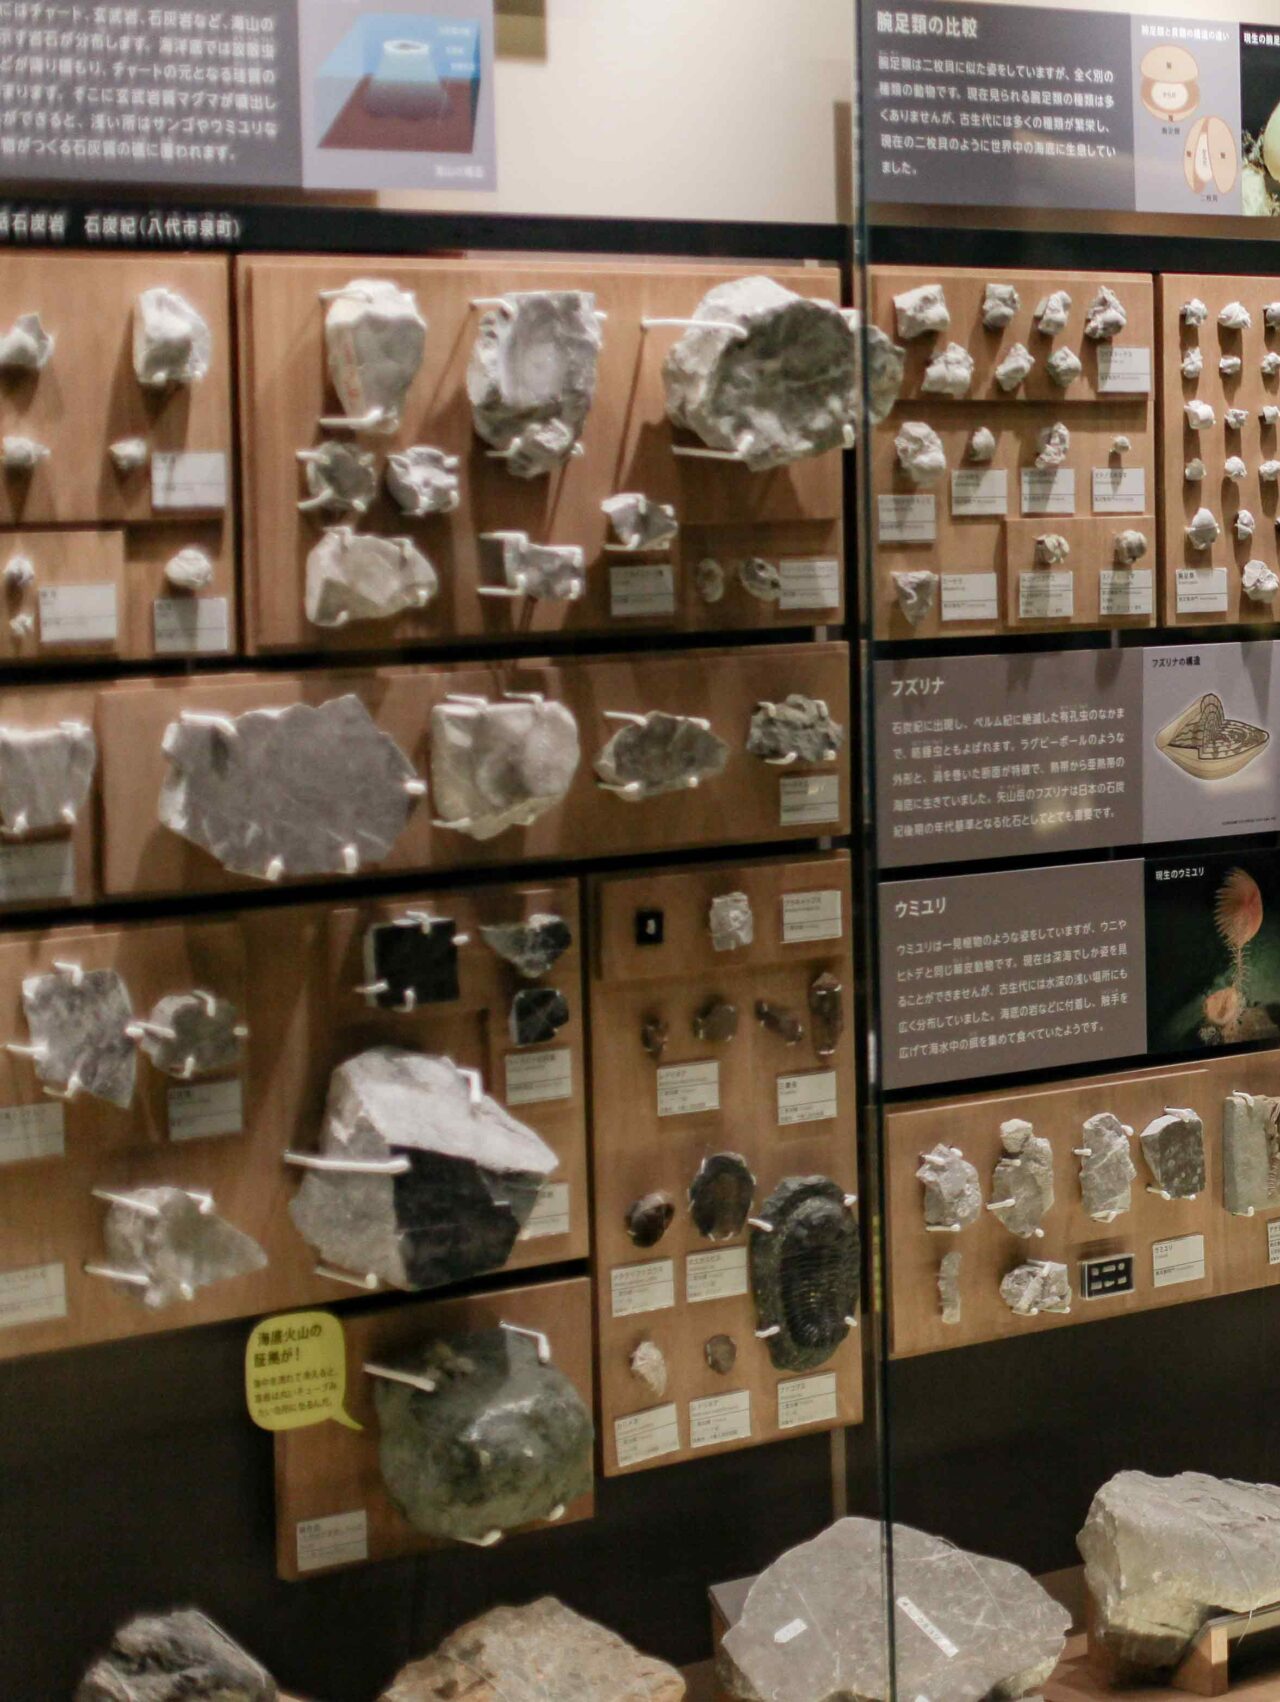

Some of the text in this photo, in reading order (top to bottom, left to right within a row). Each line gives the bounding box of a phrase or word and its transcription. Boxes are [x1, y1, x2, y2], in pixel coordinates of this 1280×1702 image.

[877, 10, 977, 39] 腕足類の比較
[882, 161, 917, 176] ました。
[891, 676, 945, 697] フズリナ
[895, 897, 947, 919] ウミユリ
